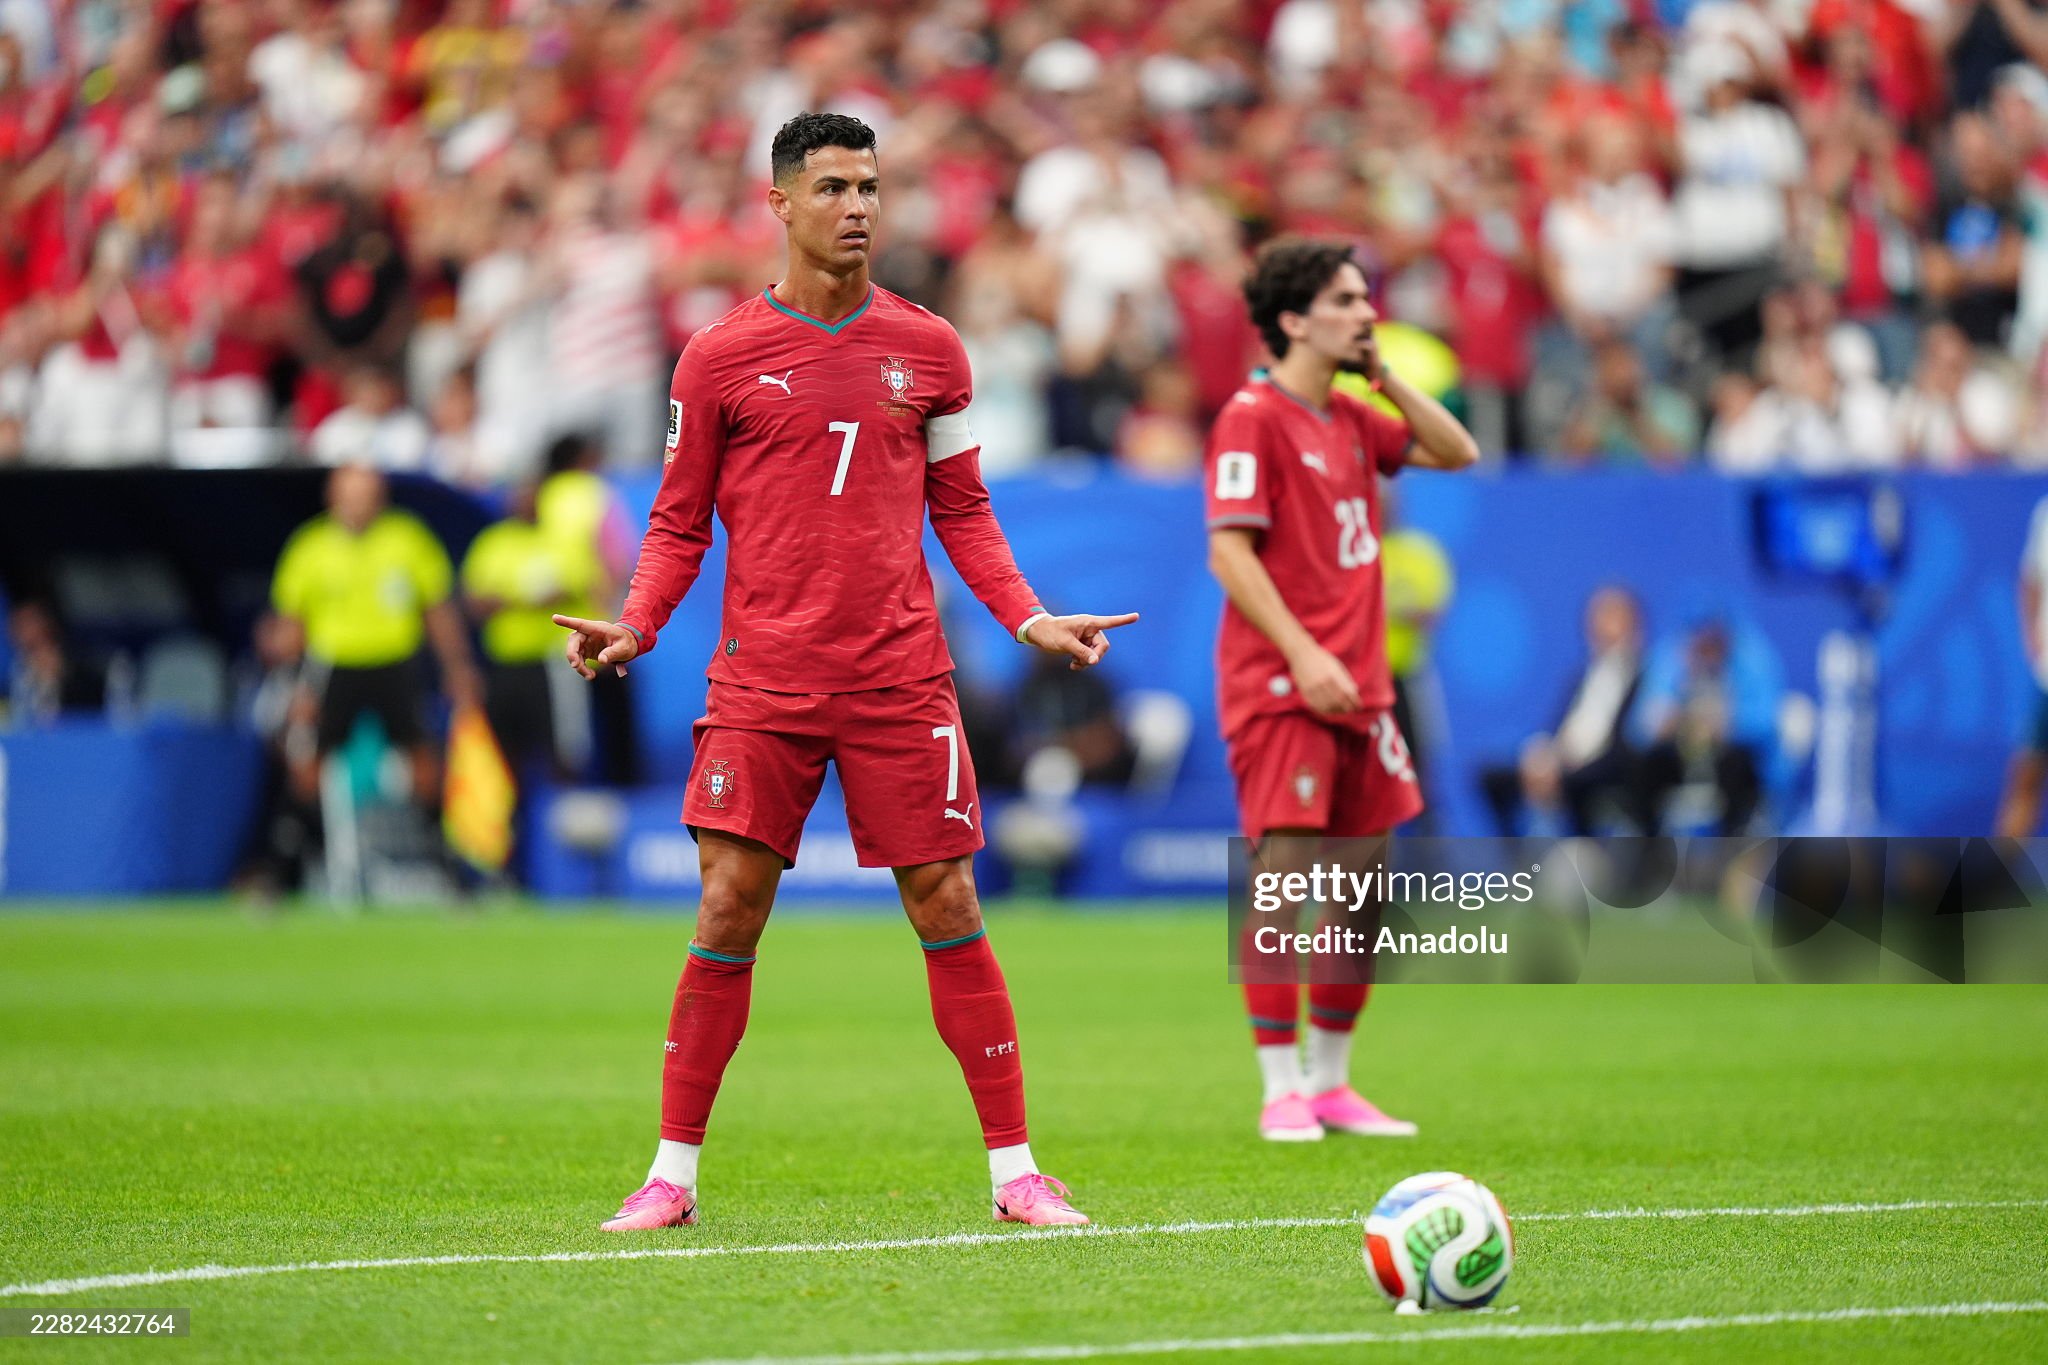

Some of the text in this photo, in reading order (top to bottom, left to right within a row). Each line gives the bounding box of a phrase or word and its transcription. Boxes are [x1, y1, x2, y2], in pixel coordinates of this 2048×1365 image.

[828, 421, 860, 496] 7
[1334, 497, 1379, 569] 23
[931, 724, 959, 801] 7
